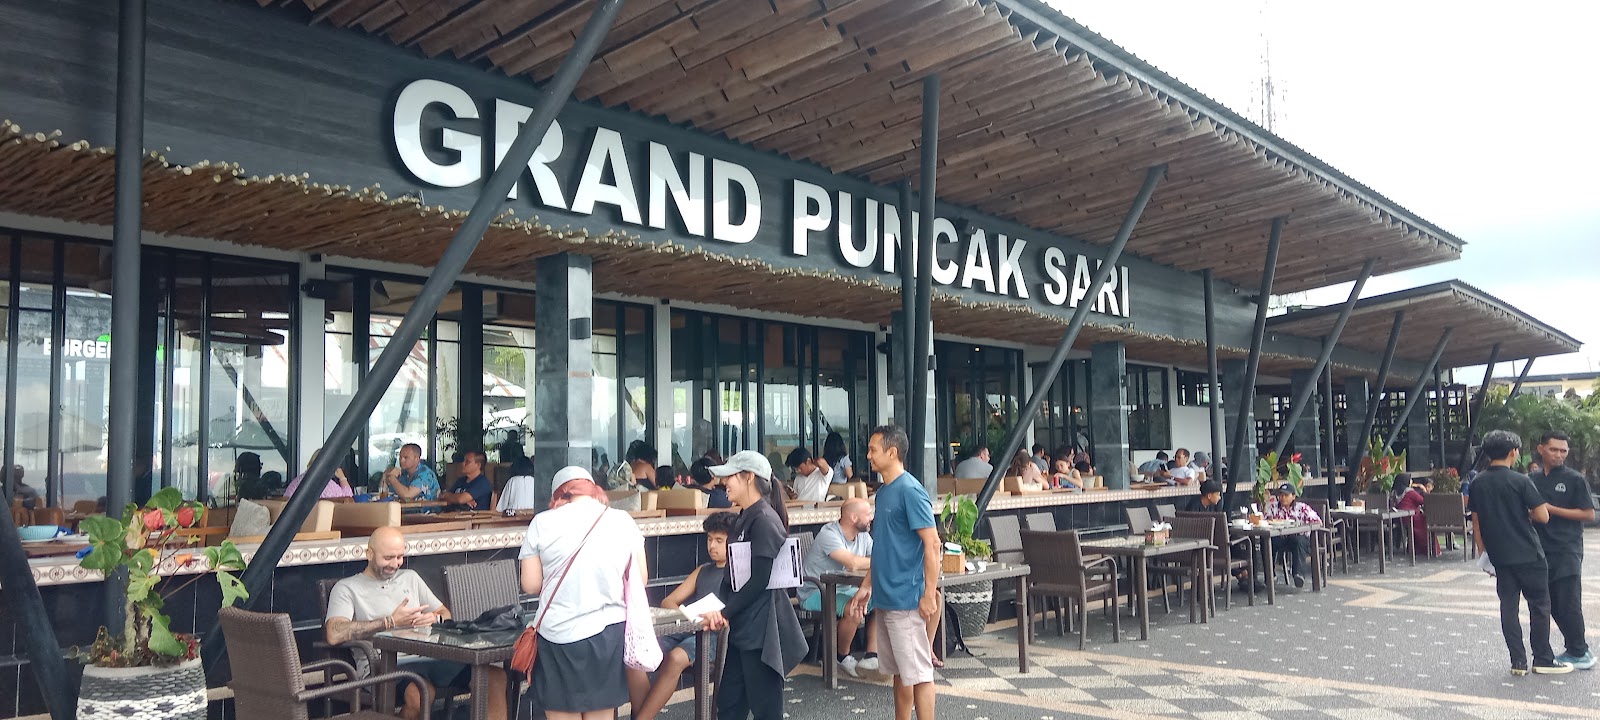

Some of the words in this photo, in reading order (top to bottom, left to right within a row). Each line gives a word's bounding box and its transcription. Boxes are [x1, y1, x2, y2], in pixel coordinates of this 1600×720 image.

[393, 78, 761, 244] GRAND
[793, 179, 1029, 299] PUNCAK
[1043, 246, 1130, 318] SARI
[43, 337, 112, 359] BRGE
